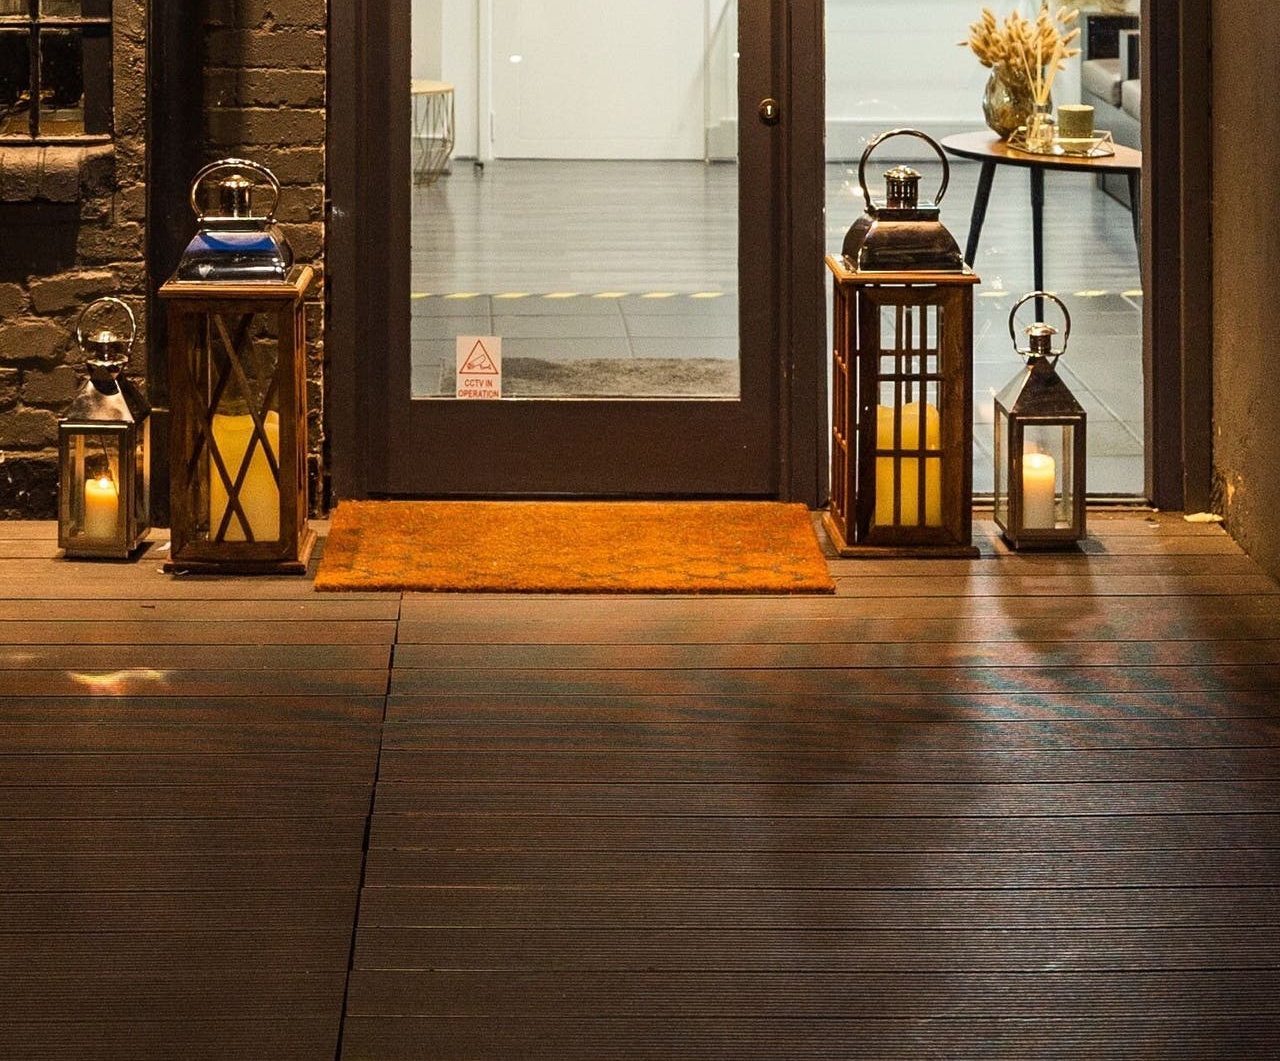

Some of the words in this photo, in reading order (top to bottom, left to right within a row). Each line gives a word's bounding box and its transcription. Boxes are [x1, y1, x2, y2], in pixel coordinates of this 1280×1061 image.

[464, 379, 484, 387] CCTV
[485, 379, 493, 387] IN
[458, 389, 499, 398] OPERATION
